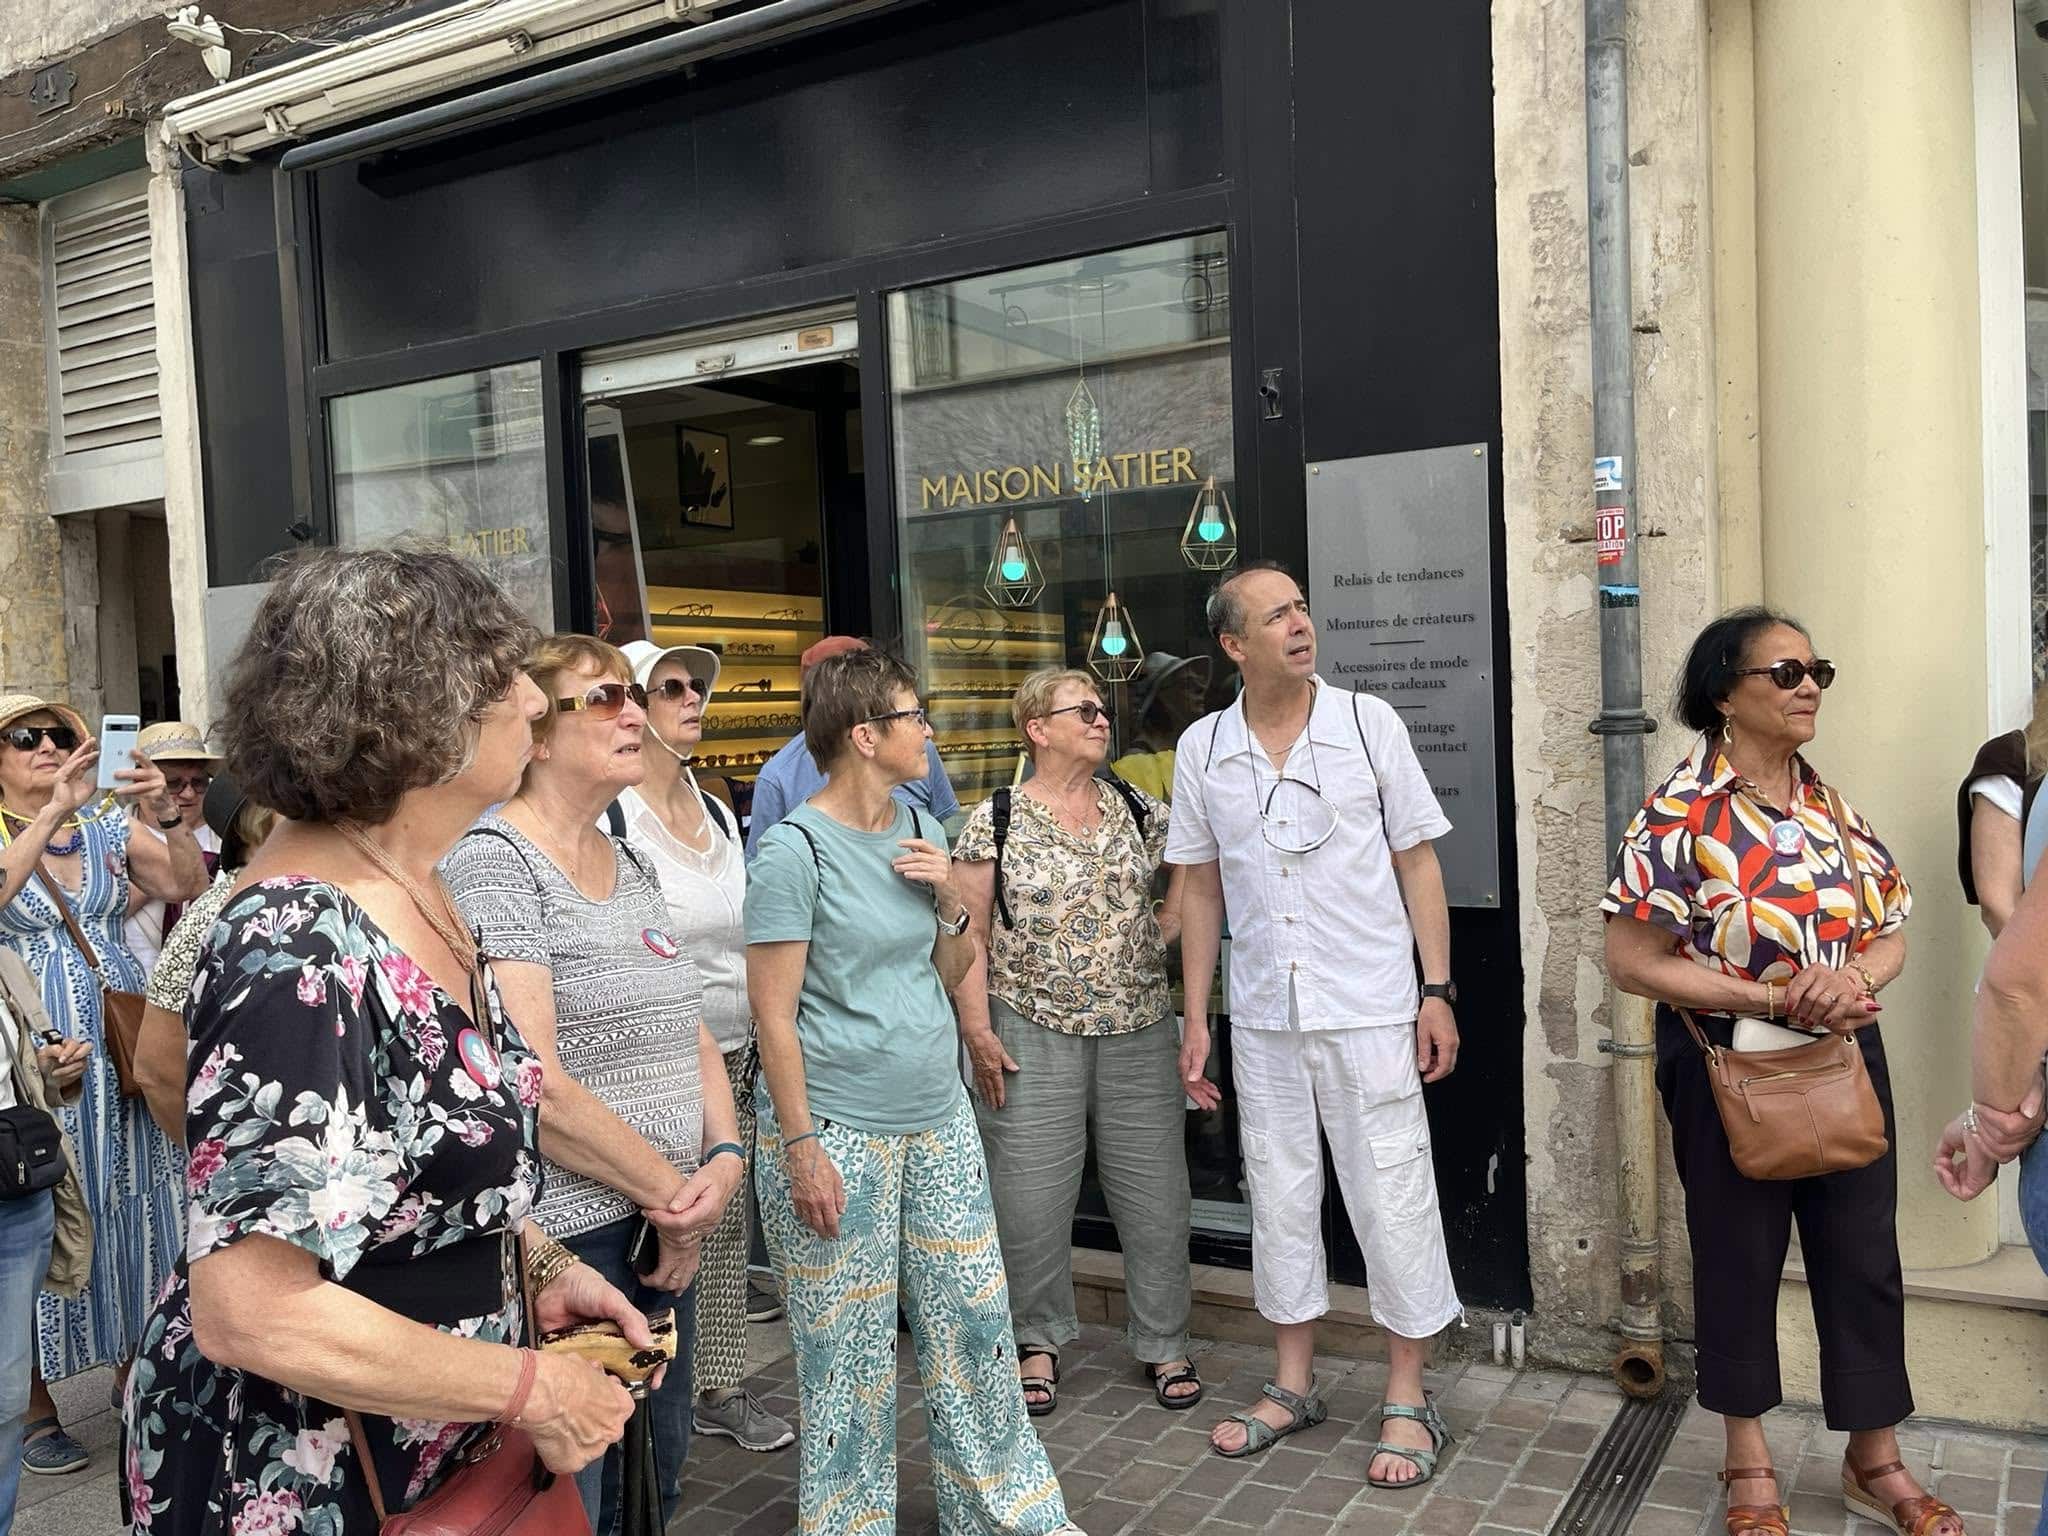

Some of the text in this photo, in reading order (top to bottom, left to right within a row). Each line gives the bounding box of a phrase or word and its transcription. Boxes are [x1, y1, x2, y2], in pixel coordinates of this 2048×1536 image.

[922, 447, 1198, 510] MAISON SATIER
[1596, 516, 1625, 541] TOP
[1333, 567, 1465, 588] Relais de tendances
[1326, 611, 1475, 632] Montures de créateurs
[1332, 655, 1470, 674] Accessoires de mode
[1391, 676, 1447, 690] cadeaux
[1406, 720, 1456, 736] vintage
[1417, 742, 1468, 753] contact
